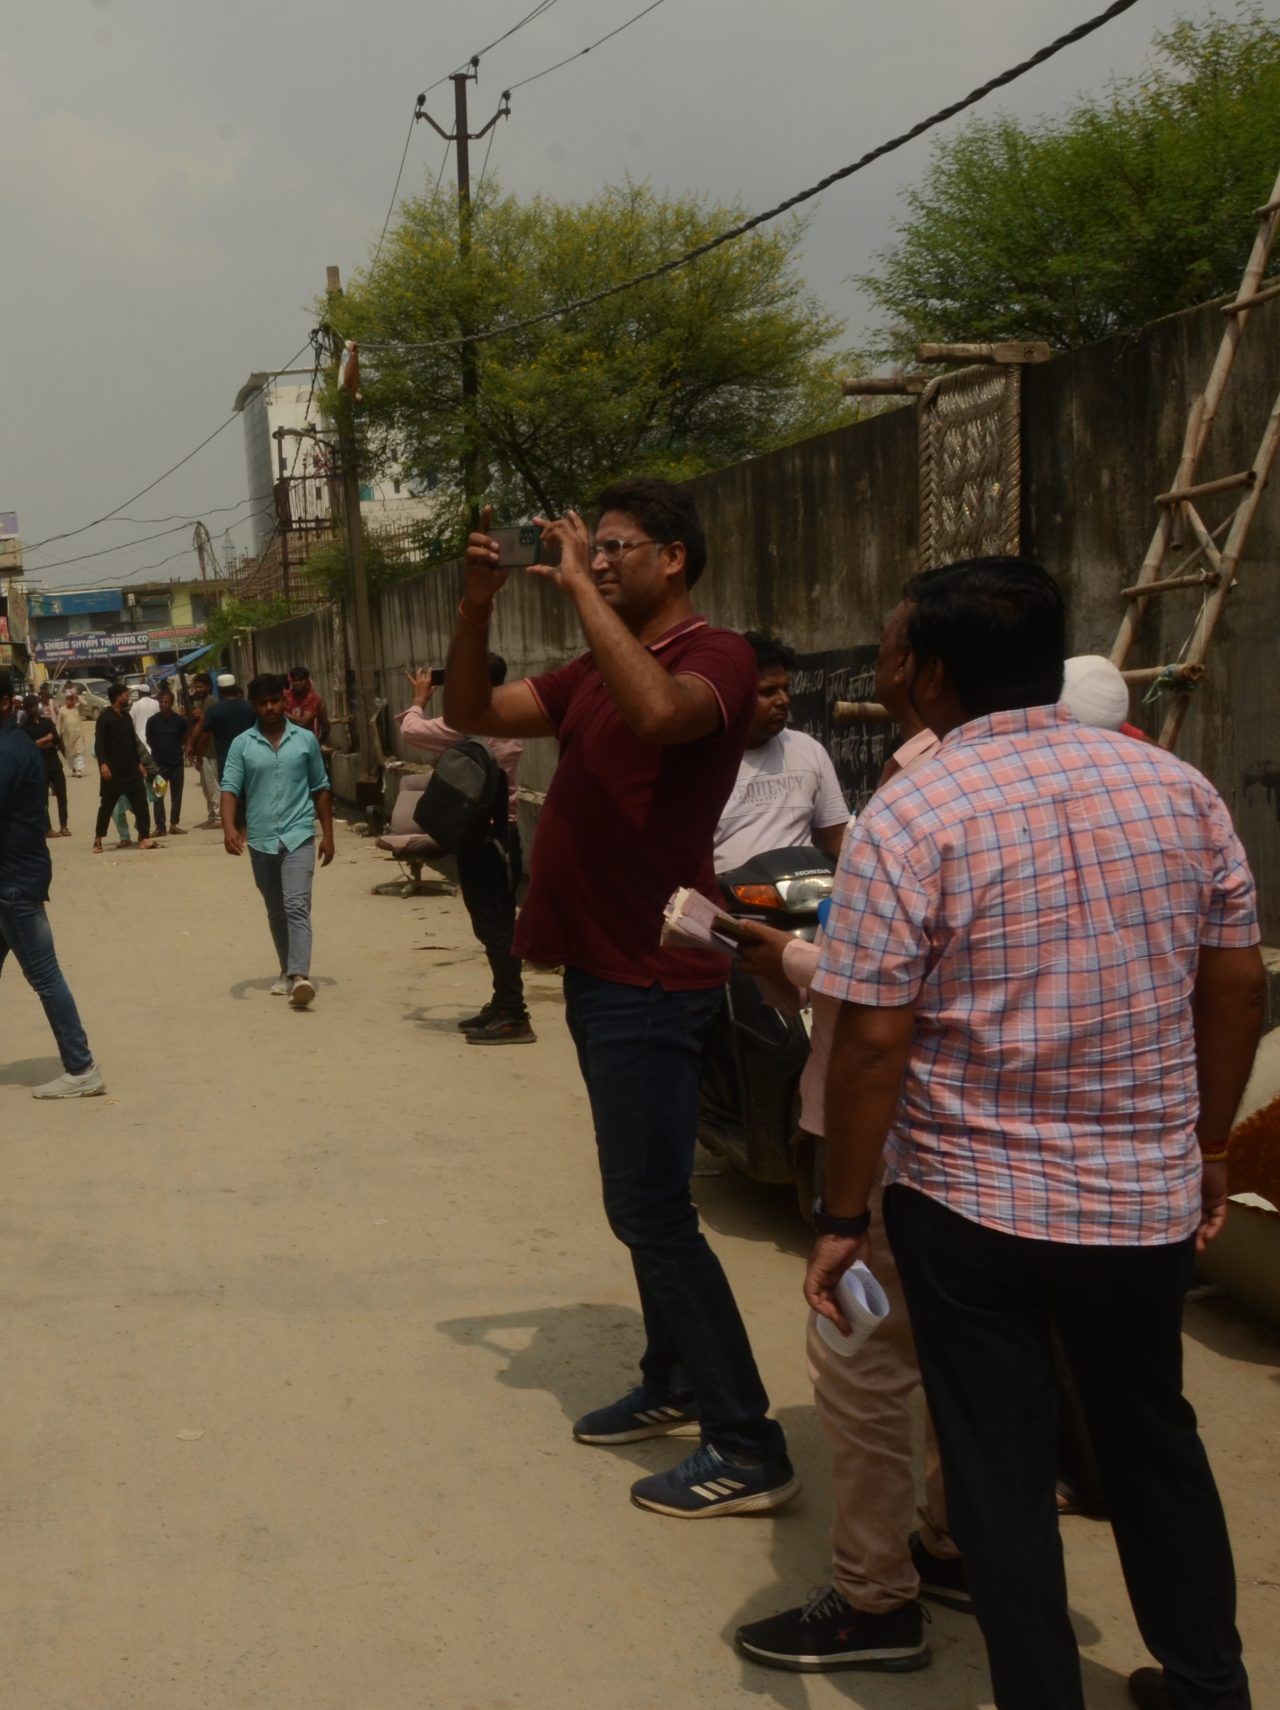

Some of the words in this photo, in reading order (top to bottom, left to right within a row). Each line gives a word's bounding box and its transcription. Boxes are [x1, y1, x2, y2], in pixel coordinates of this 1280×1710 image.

[44, 641, 69, 651] SHREE
[71, 639, 98, 649] SHYAM
[100, 636, 136, 646] TRADING
[794, 868, 832, 877] HONDA
